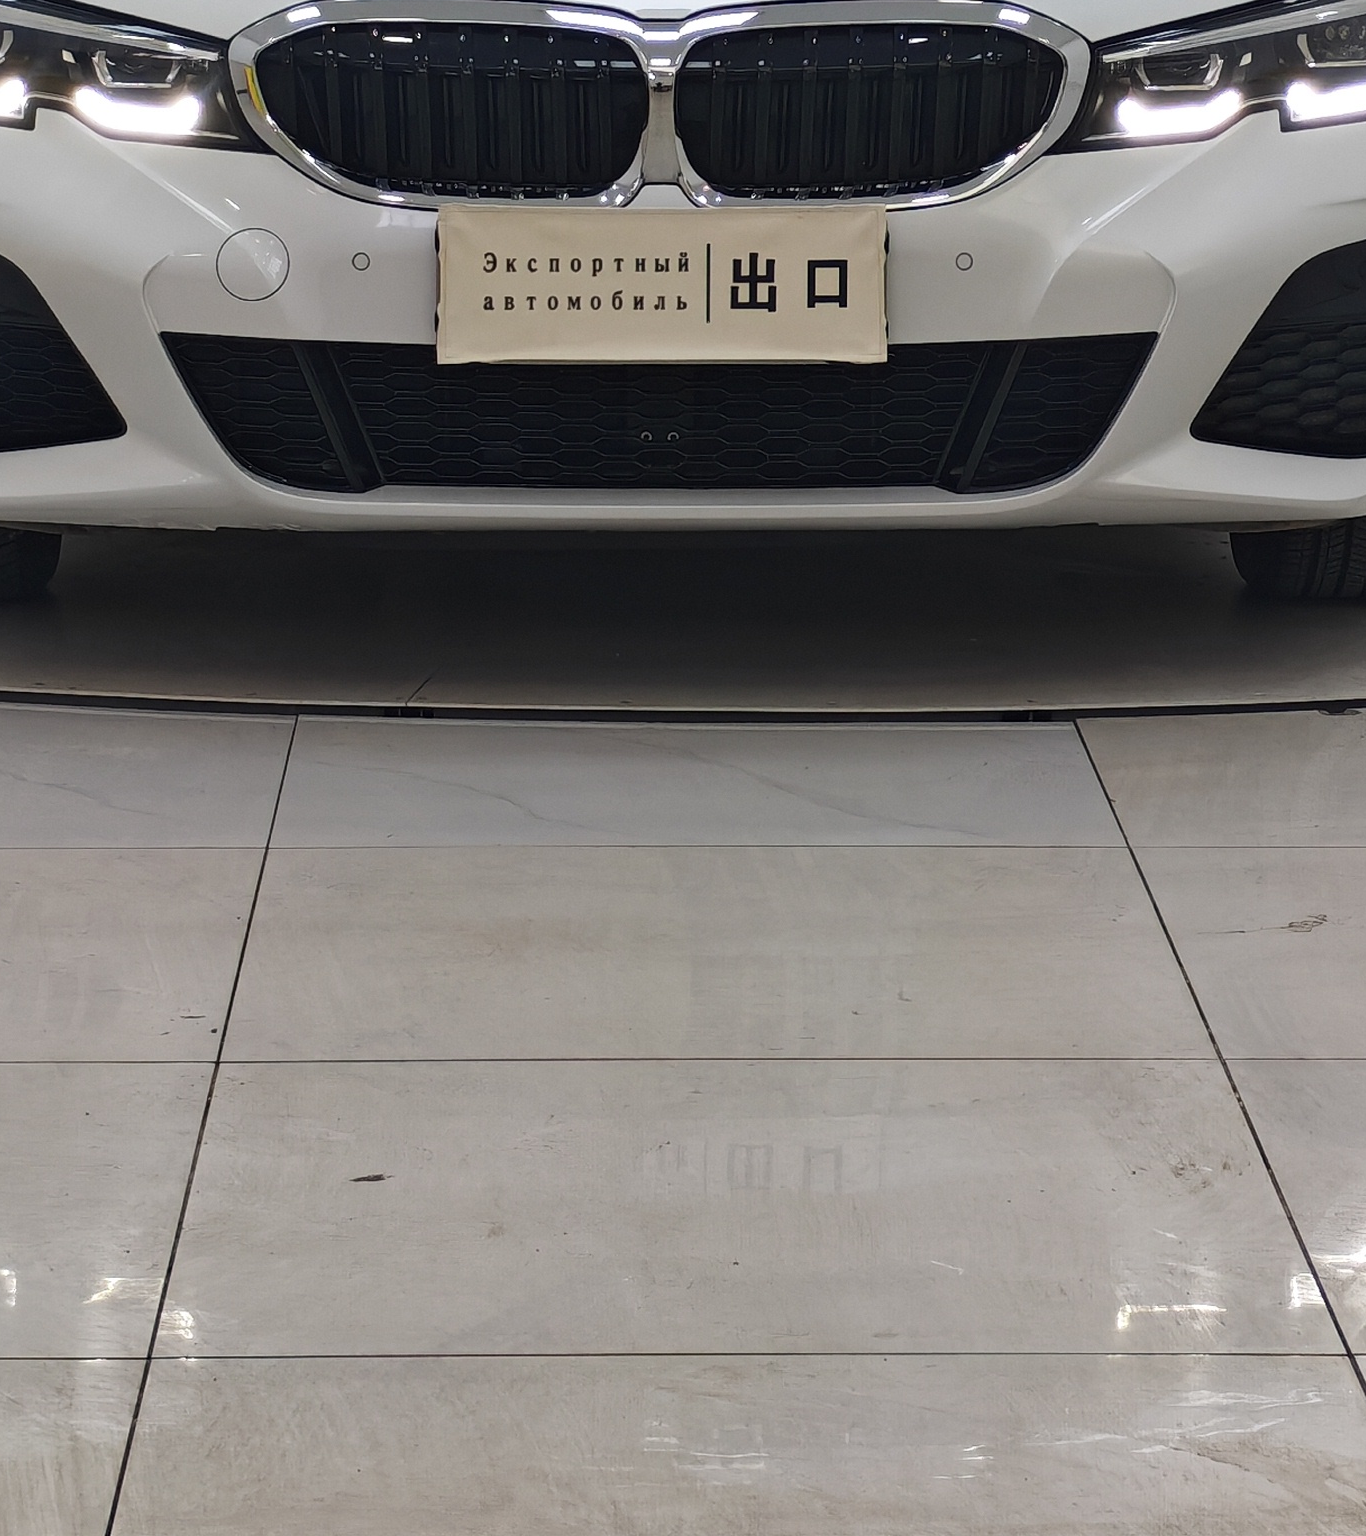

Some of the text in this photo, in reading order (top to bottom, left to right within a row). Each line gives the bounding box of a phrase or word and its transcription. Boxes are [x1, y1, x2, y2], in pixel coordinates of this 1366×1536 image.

[482, 251, 691, 278] Экспортный
[729, 252, 850, 313] 出口
[482, 290, 689, 312] автомобиль
